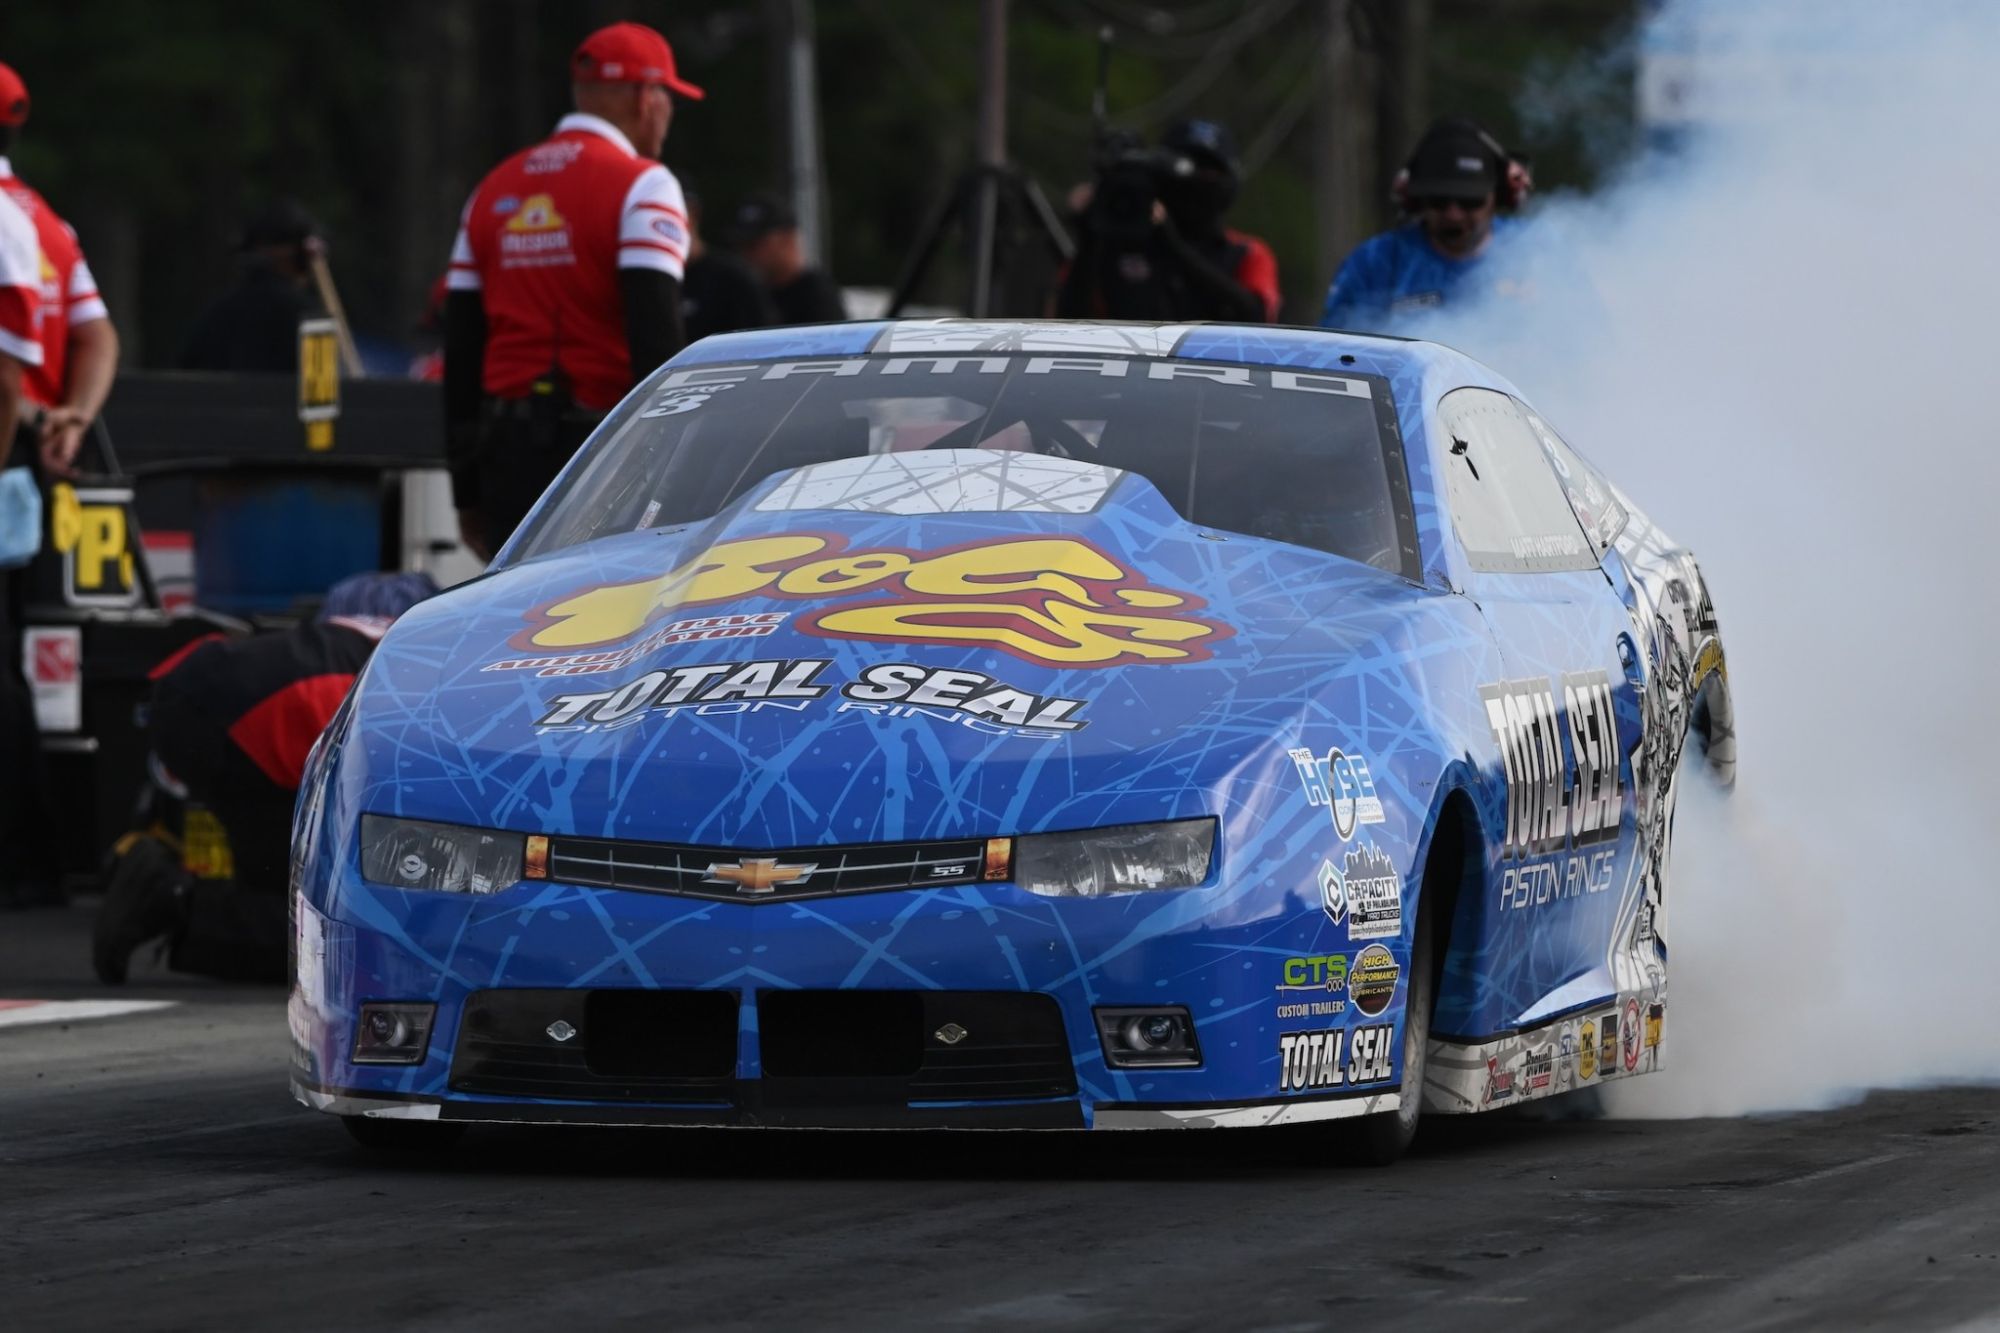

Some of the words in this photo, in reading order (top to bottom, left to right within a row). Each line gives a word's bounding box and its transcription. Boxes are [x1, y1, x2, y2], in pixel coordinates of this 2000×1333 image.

[656, 357, 1372, 400] CAMARO
[640, 394, 711, 418] 3
[535, 659, 833, 729] TOTAL
[843, 661, 1090, 731] SEAL
[535, 700, 811, 736] PISTON
[836, 700, 1066, 740] RINGS
[1291, 751, 1313, 760] THE
[1484, 690, 1569, 848] TOTAL
[1564, 683, 1623, 838] SEAL
[1297, 758, 1377, 804] HOSE
[928, 865, 966, 877] SS
[1500, 859, 1559, 911] PISTON
[1563, 850, 1616, 900] RINGS
[1346, 877, 1398, 900] CAPACITY
[1284, 954, 1348, 986] CTS
[1351, 970, 1398, 983] PERFORMANCE
[1362, 954, 1390, 968] HIGH
[1277, 1002, 1309, 1018] CUSTOM
[1311, 1001, 1346, 1016] TRAILERS
[1280, 1028, 1344, 1091] TOTAL
[1348, 1025, 1394, 1087] SEAL
